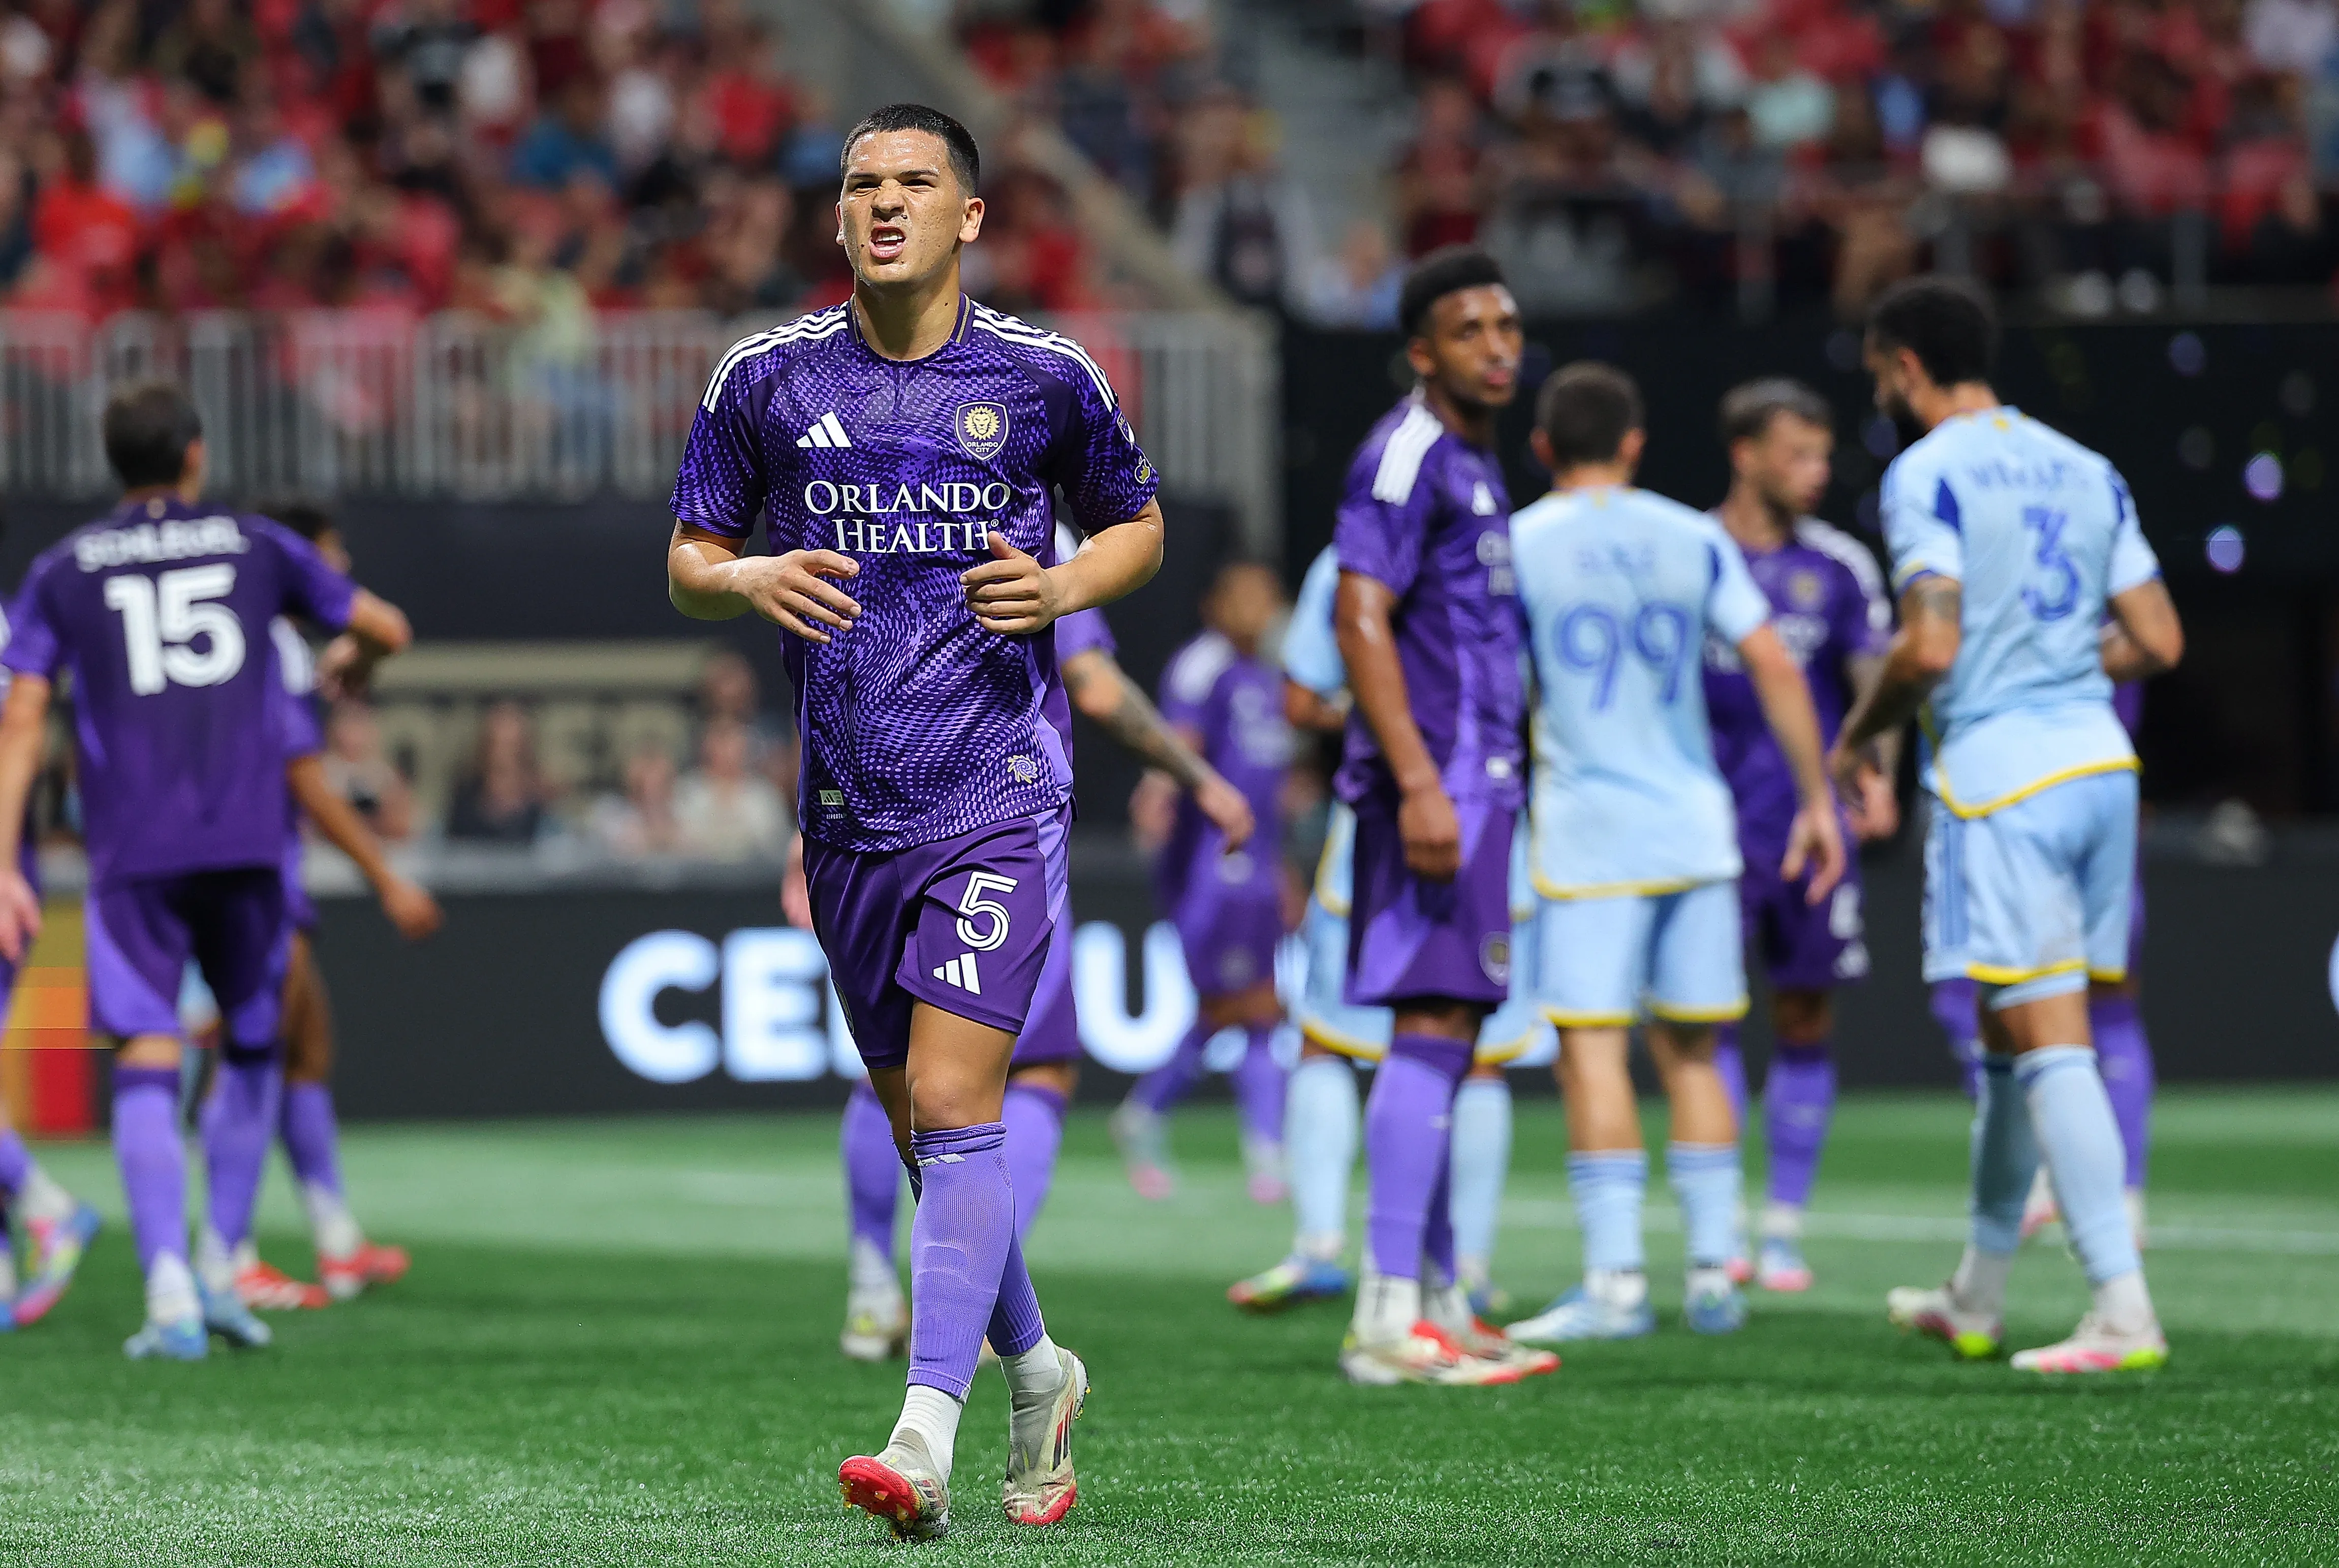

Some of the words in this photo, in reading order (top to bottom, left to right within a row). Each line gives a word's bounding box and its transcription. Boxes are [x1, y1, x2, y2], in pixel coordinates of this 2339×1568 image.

[804, 480, 1010, 514] ORLANDO
[2021, 507, 2080, 620] 3
[105, 562, 246, 696] 15
[1555, 602, 1692, 711] 99
[956, 871, 1018, 951] 5
